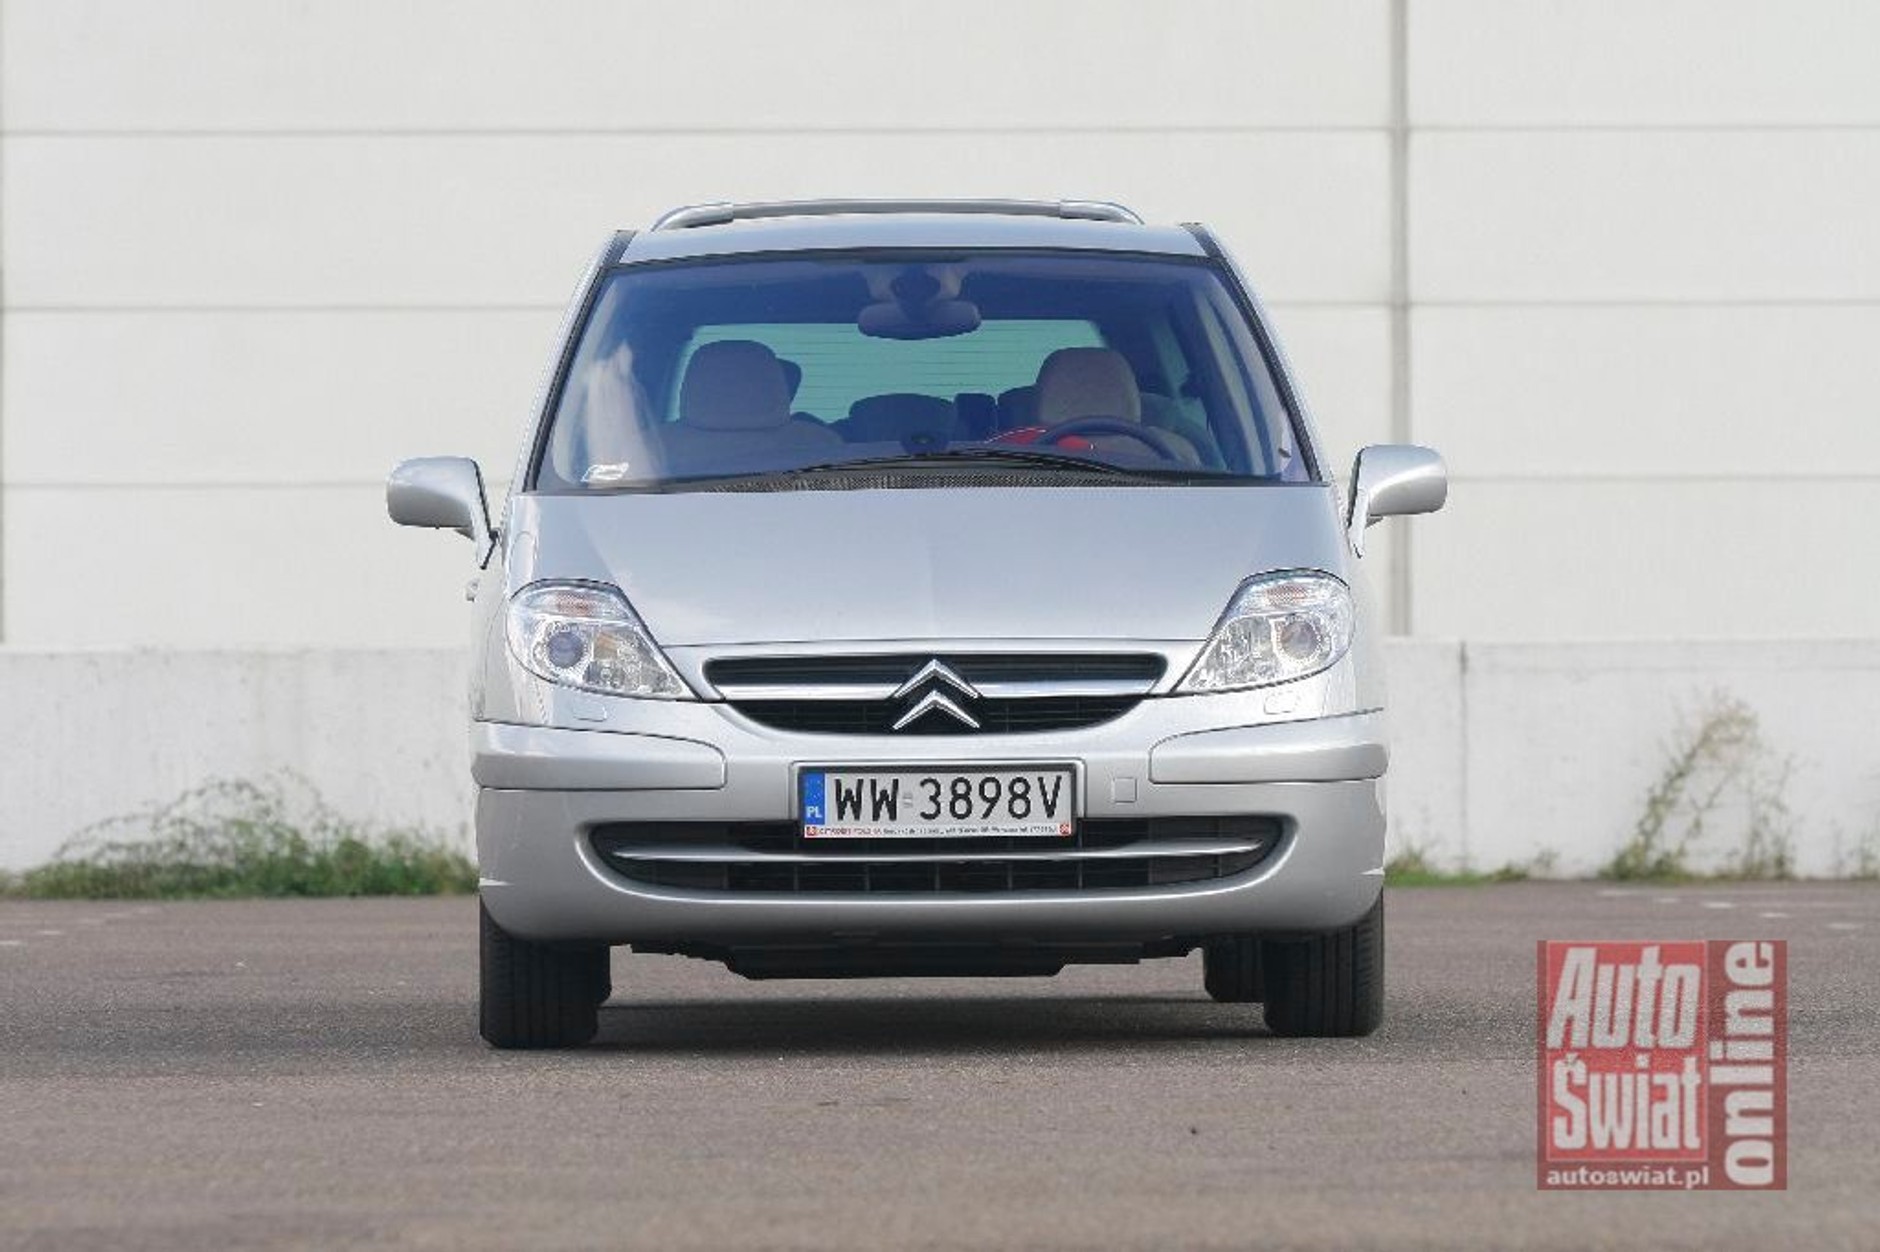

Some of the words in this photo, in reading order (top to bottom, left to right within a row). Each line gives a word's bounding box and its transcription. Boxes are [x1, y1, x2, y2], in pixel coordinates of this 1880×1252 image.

[806, 805, 822, 818] PL
[835, 778, 899, 821] WW
[919, 776, 1062, 820] 3898V
